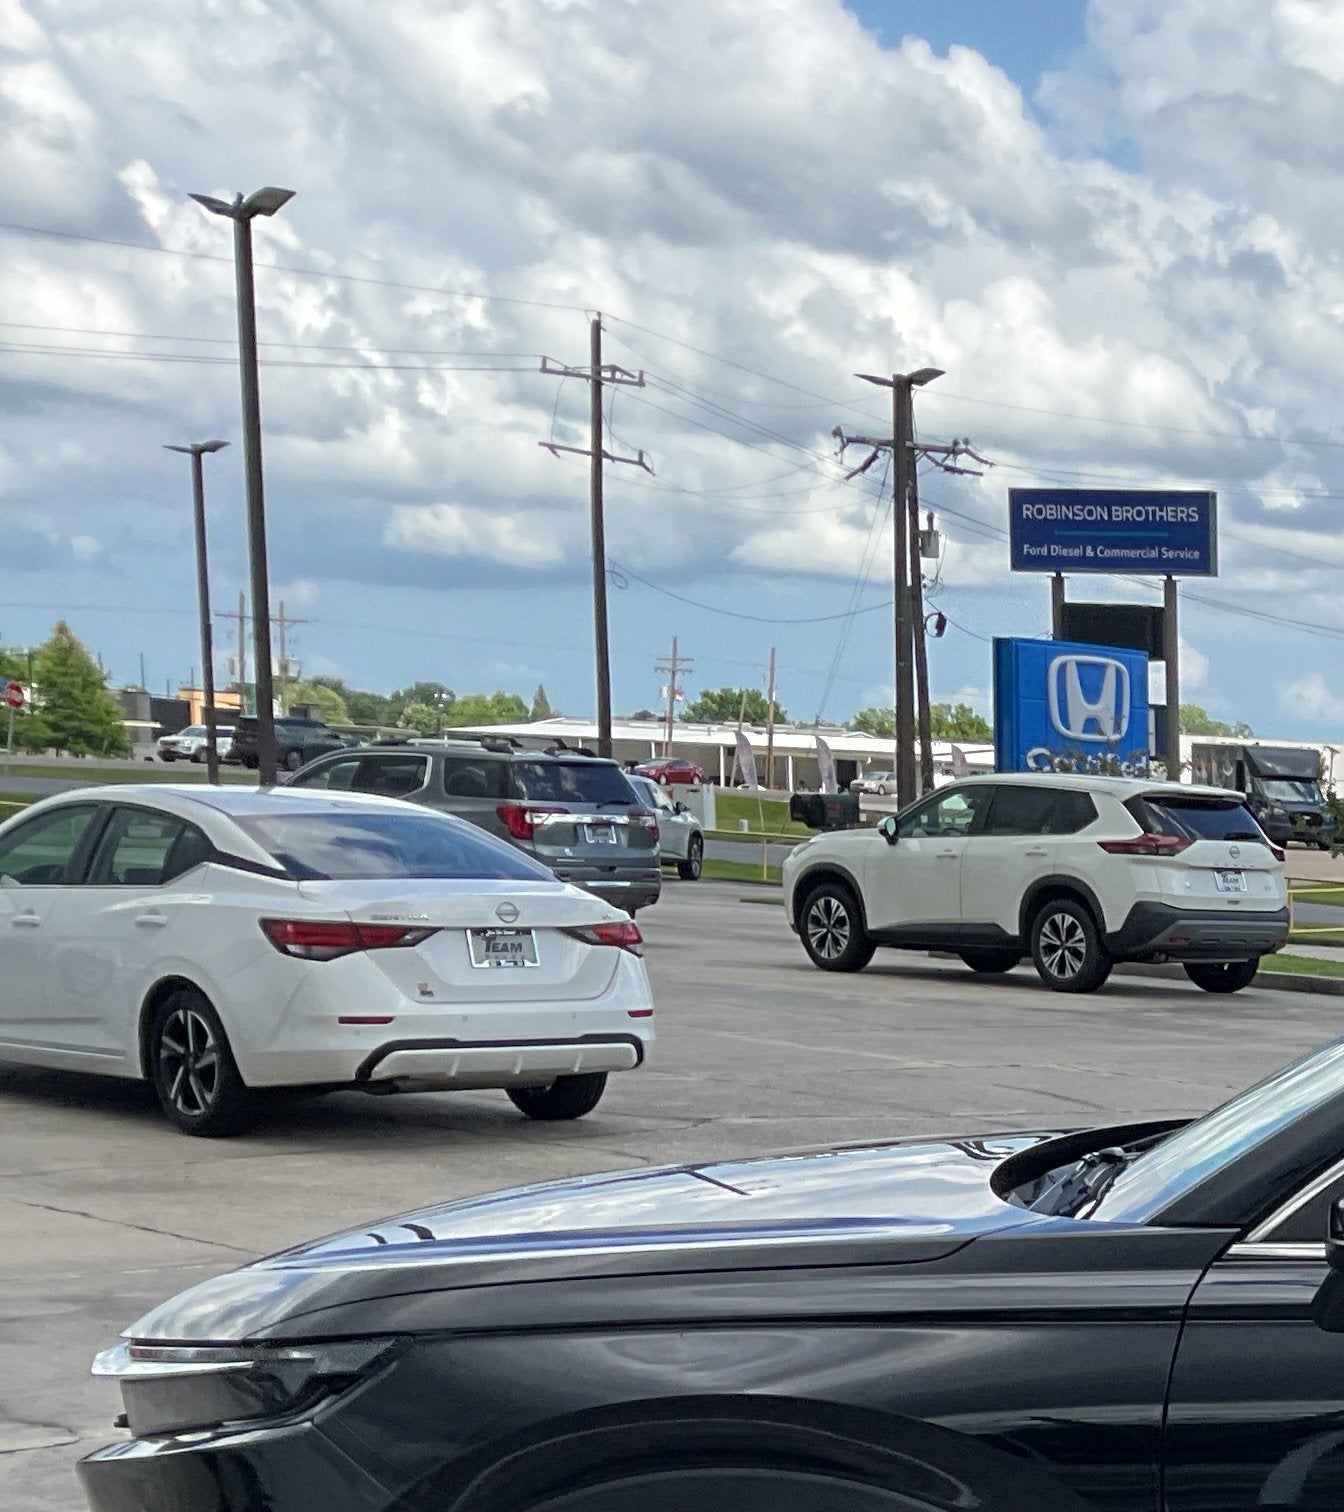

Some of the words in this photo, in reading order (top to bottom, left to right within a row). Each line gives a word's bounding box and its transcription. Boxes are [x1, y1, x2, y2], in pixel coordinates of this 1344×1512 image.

[1022, 504, 1108, 521] ROBINSON
[1111, 505, 1199, 523] BROTHERS
[1023, 544, 1048, 556] Ford
[1050, 545, 1083, 557] Diesel
[1085, 546, 1095, 557] &
[1097, 546, 1159, 559] Commercial
[1161, 547, 1200, 560] Service
[481, 935, 523, 953] TEAM
